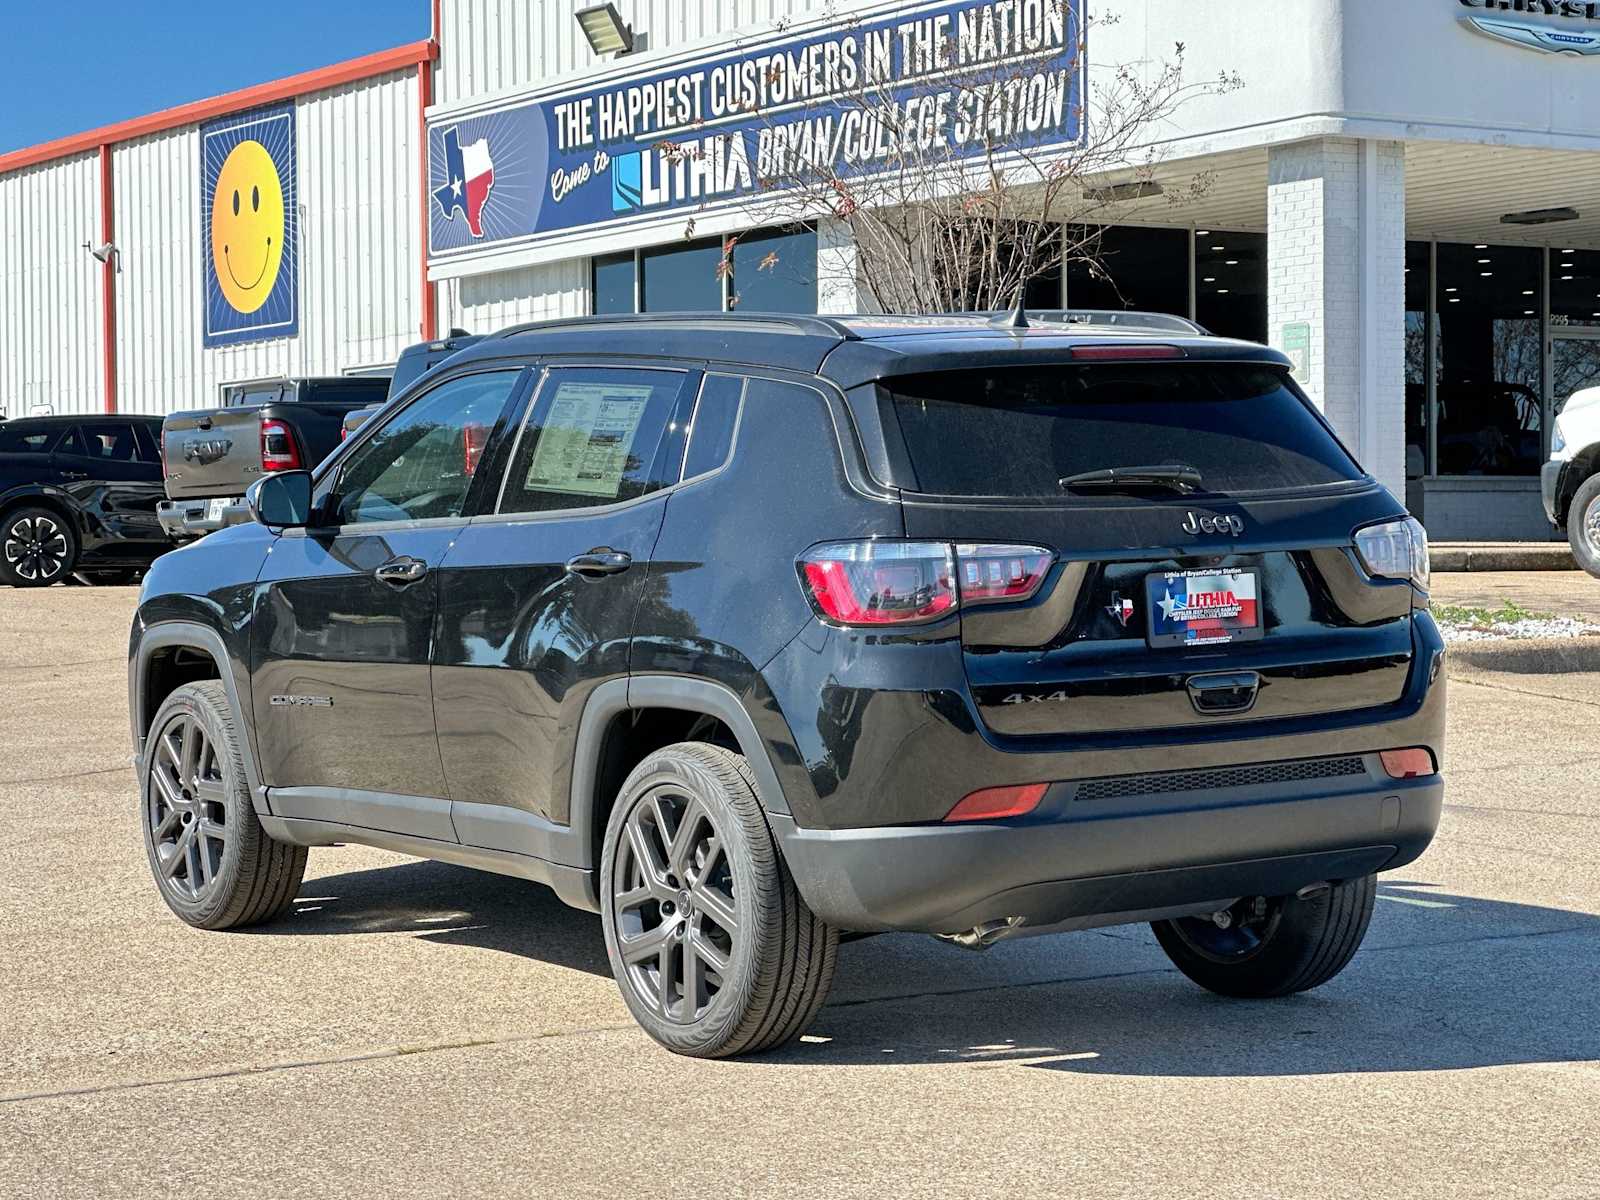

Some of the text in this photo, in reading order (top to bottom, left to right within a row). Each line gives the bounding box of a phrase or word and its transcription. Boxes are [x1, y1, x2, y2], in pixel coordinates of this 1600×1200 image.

[554, 0, 1063, 149] THE HAPPIEST CUSTOMERS IN THE NATION
[551, 161, 591, 201] Come
[593, 150, 610, 174] to
[641, 131, 752, 206] LITHIA
[955, 69, 1066, 143] STATION
[1182, 511, 1245, 537] Jeep
[1187, 591, 1239, 609] LITHIA
